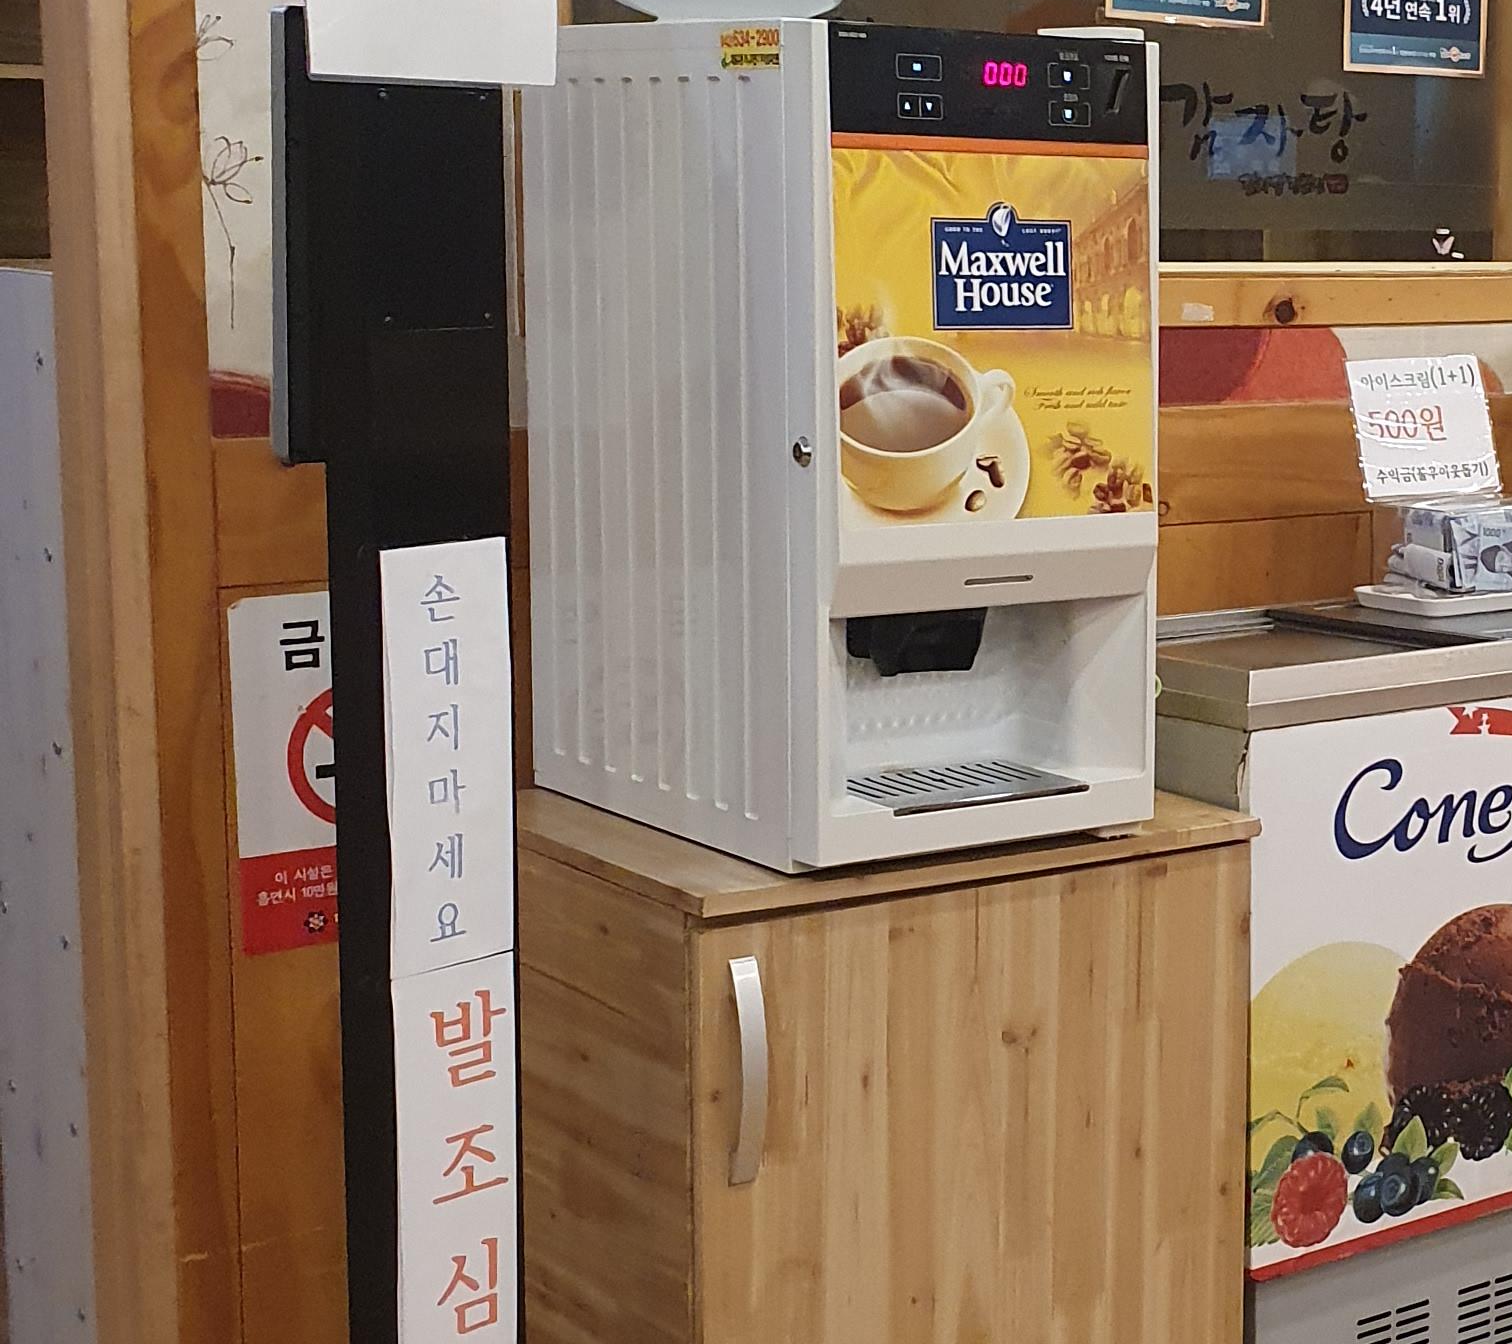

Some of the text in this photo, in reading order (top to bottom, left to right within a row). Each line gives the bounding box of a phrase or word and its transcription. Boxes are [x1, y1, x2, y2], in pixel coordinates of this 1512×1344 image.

[983, 61, 1028, 87] 000
[938, 240, 1066, 277] Maxwell
[954, 278, 1053, 312] House
[1360, 363, 1475, 391] 아이스크림(1+1)
[1368, 405, 1447, 441] 500원
[280, 620, 325, 671] 금
[293, 865, 333, 882] 시설은
[430, 988, 510, 1335] 발조심
